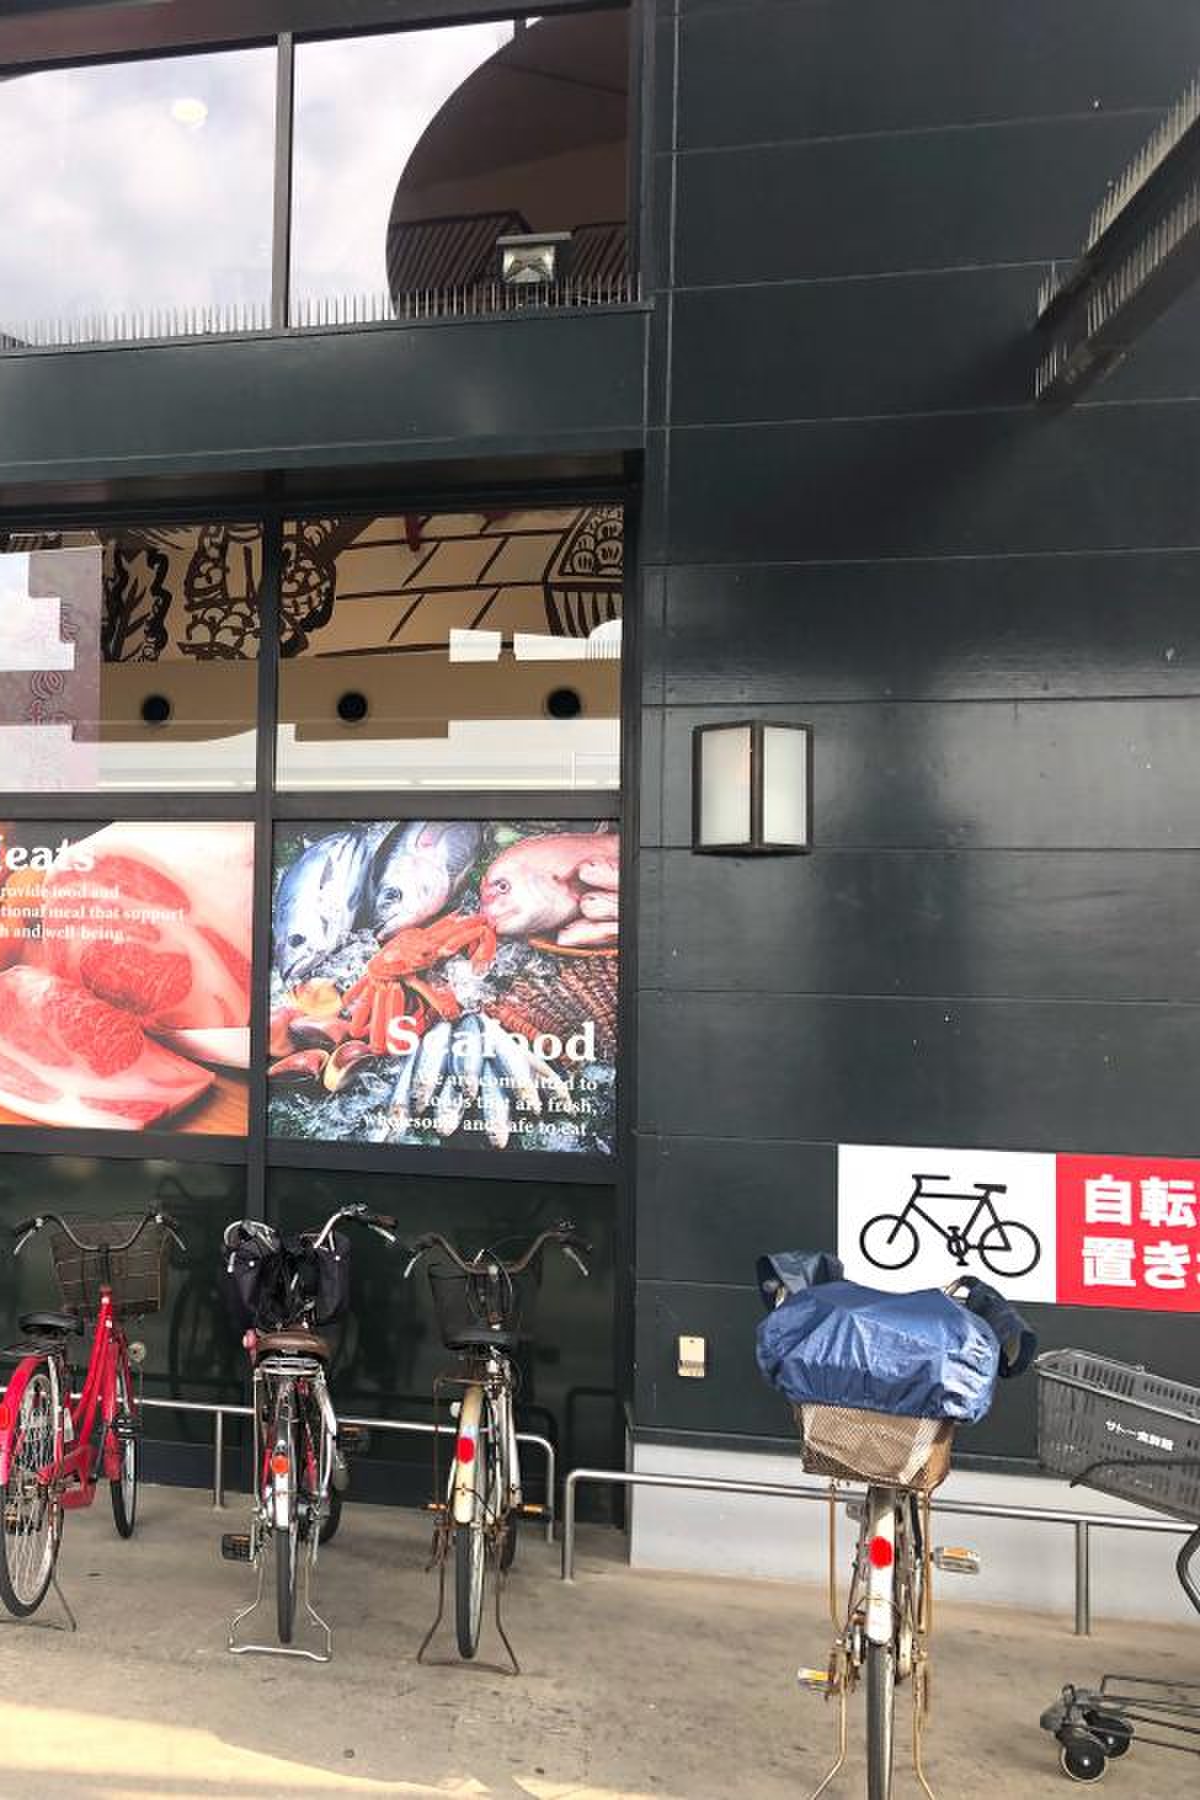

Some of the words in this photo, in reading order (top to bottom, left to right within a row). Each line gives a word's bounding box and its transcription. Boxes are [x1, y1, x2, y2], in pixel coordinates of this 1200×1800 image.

[579, 1077, 597, 1091] to
[476, 1095, 509, 1111] tt
[504, 1118, 535, 1135] afe
[1081, 1236, 1200, 1290] 置き
